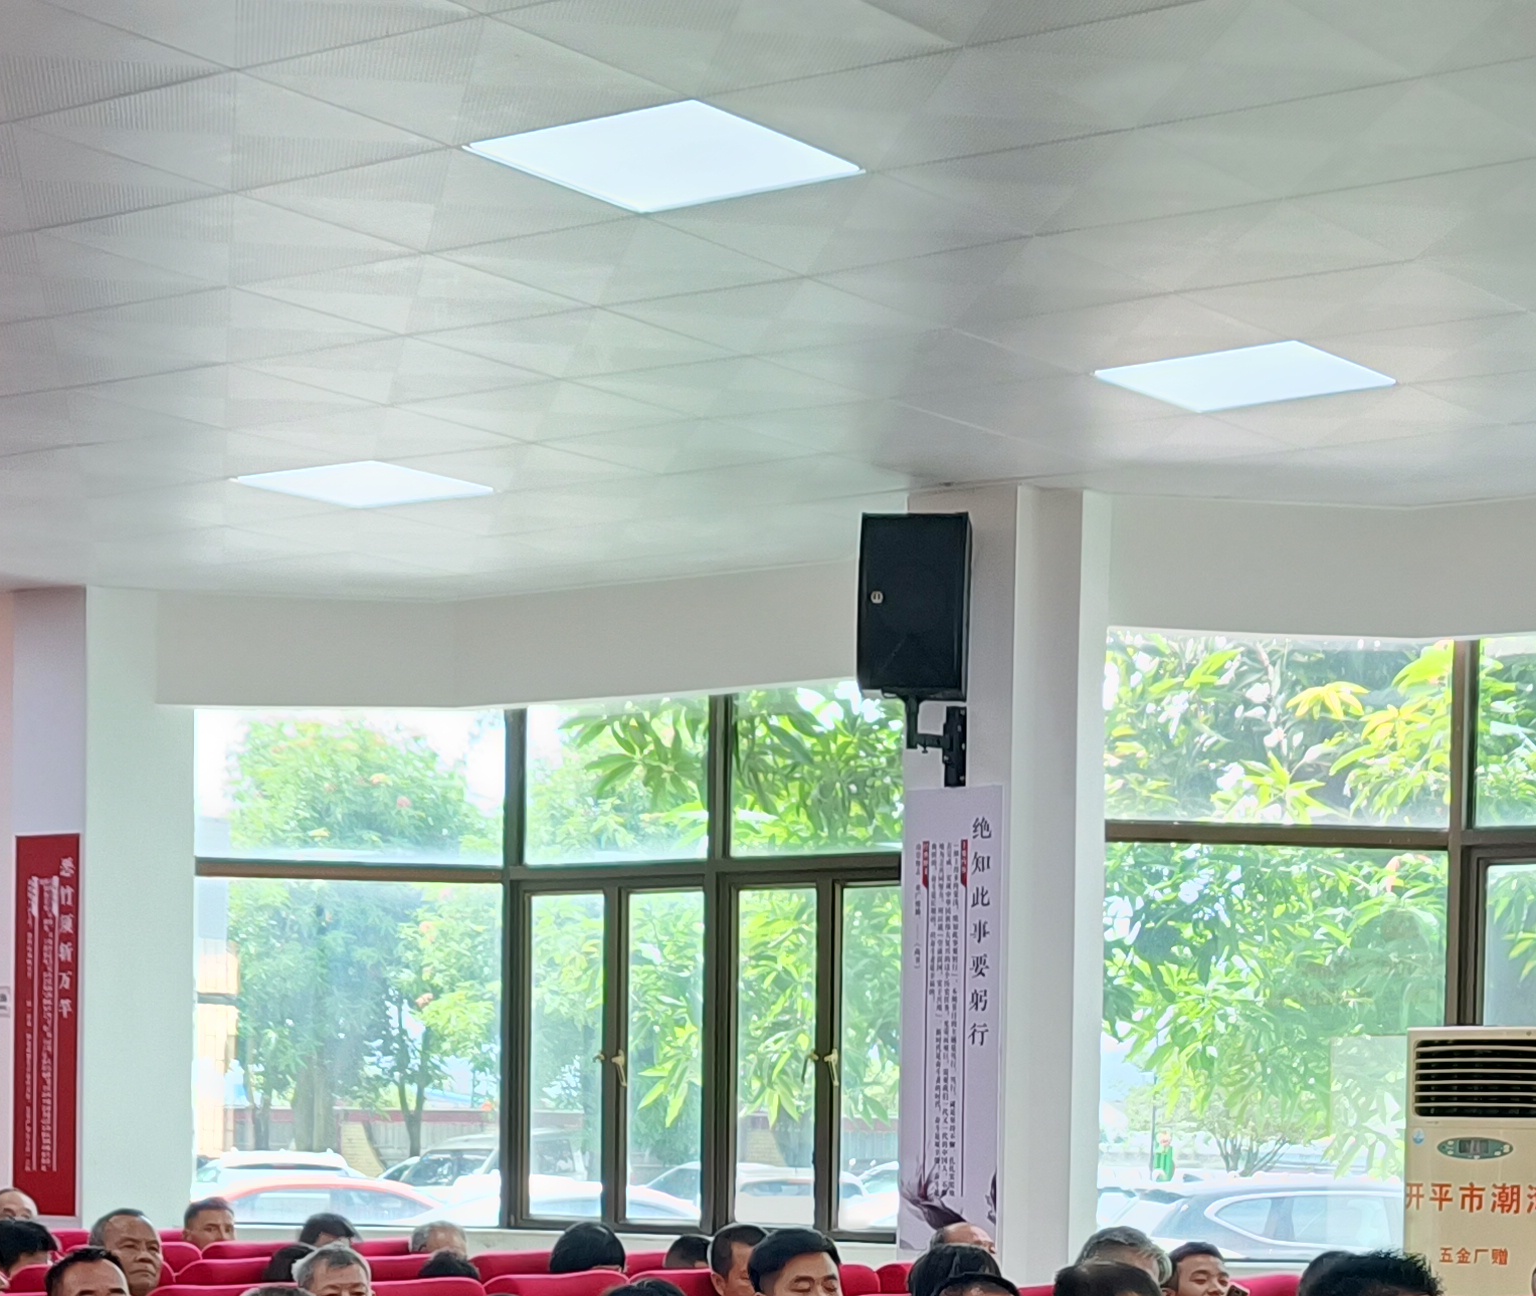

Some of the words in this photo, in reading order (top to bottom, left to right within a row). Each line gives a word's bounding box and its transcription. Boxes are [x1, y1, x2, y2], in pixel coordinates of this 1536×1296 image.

[968, 816, 992, 1047] 绝知此事要躬行
[1439, 1247, 1508, 1266] 五金厂赠
